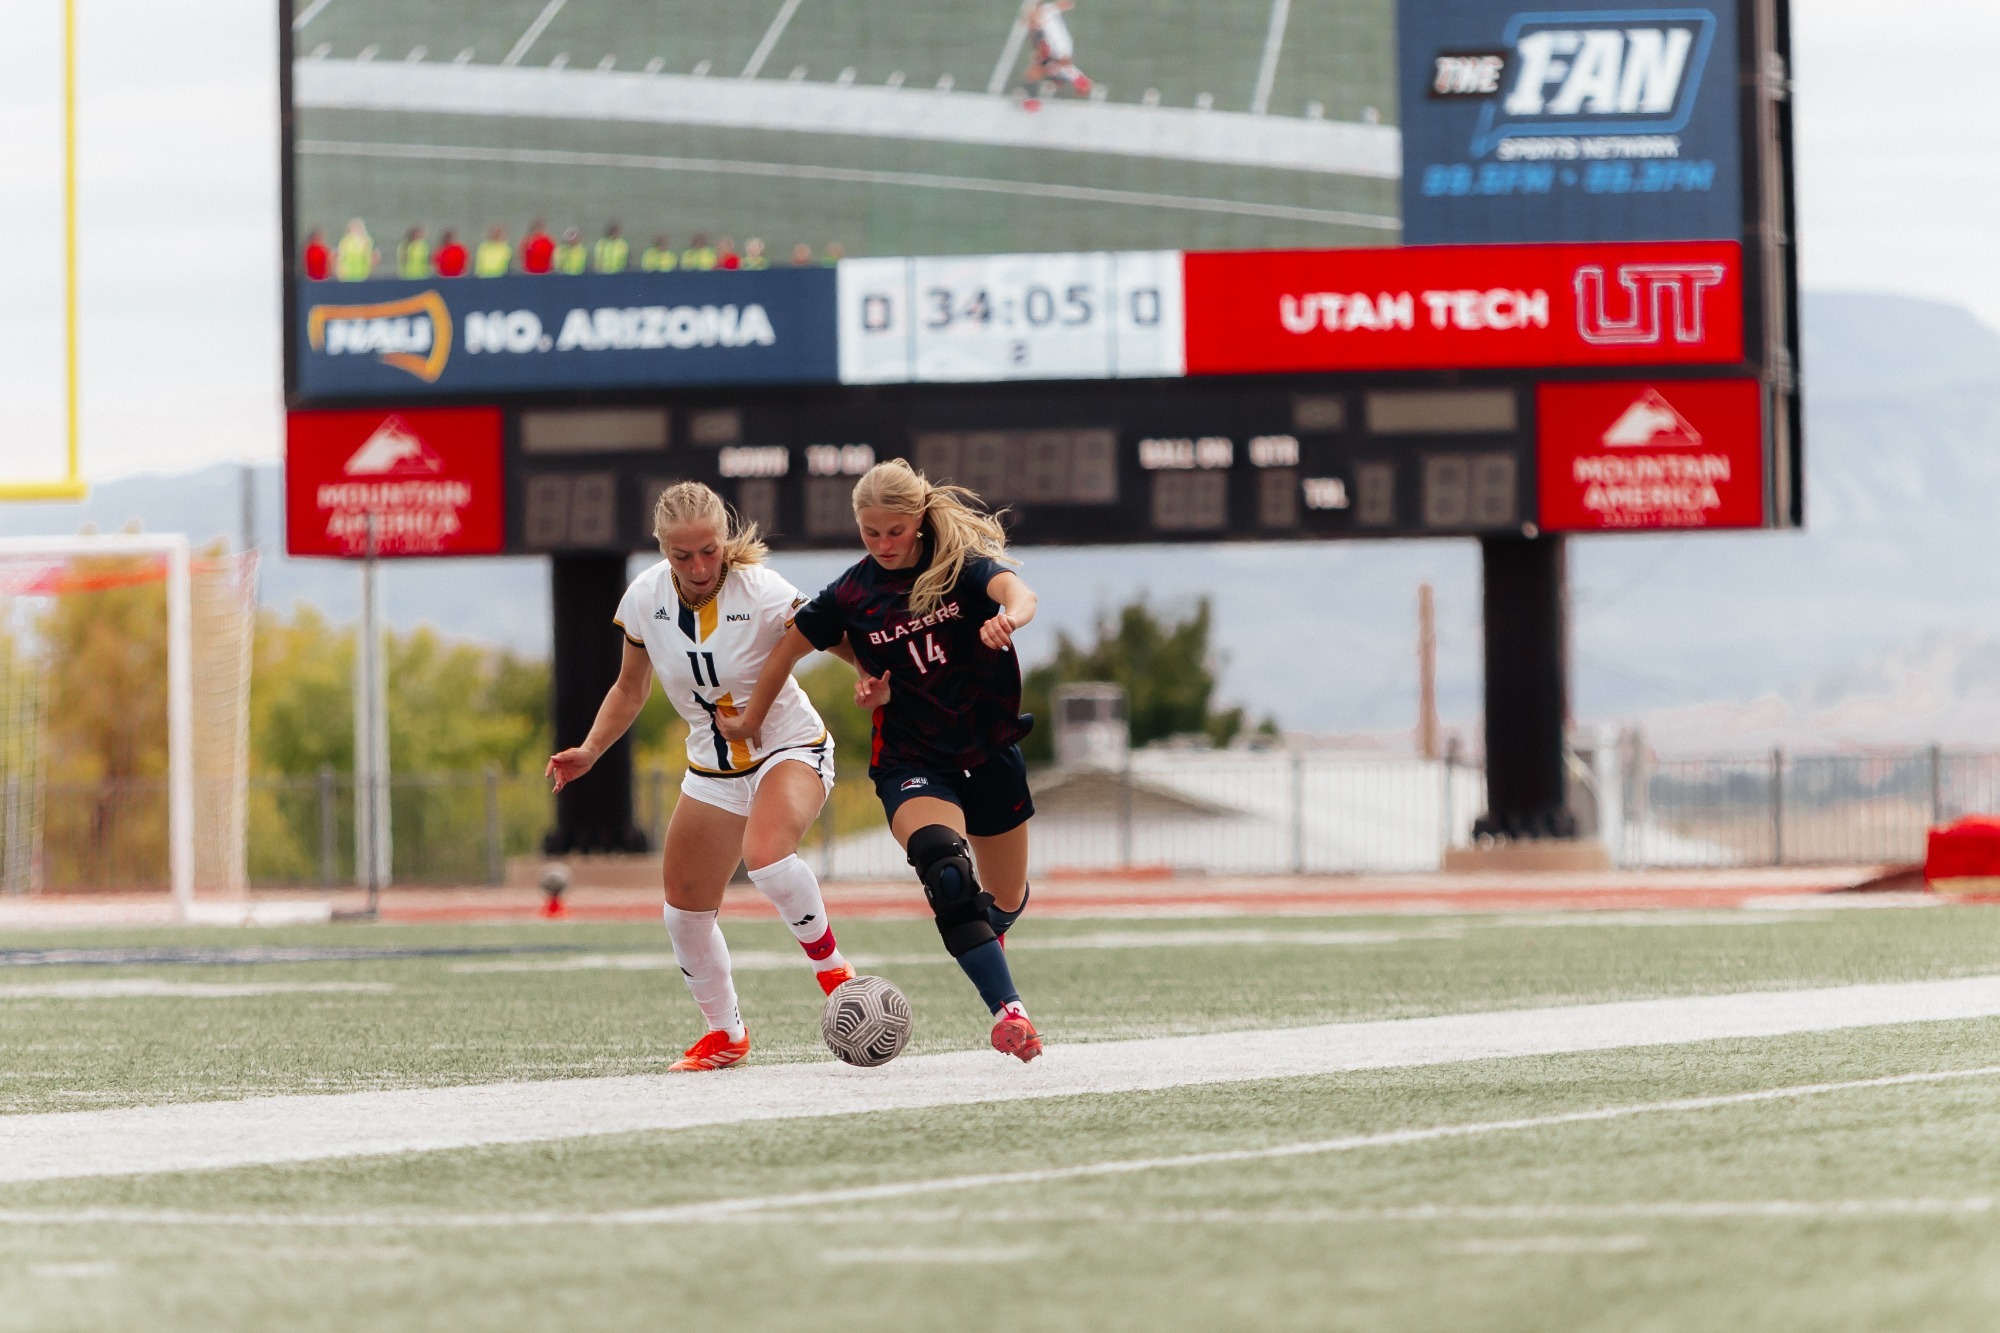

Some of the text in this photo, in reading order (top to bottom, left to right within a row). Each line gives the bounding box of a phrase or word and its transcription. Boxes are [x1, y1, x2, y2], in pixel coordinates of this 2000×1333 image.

[1434, 27, 1694, 115] THE FAN
[1497, 135, 1681, 162] SPORTS NETWORK
[926, 287, 1092, 328] 34:05
[1280, 288, 1550, 334] UTAH TECH
[464, 304, 776, 355] NO. ARIZONA
[1573, 454, 1731, 483] MOUNTAIN
[1584, 483, 1721, 511] AMERICA
[653, 614, 671, 622] adidas
[726, 613, 751, 622] NAU
[869, 601, 960, 645] BLAZERS
[686, 651, 720, 688] 11
[908, 633, 947, 675] 14
